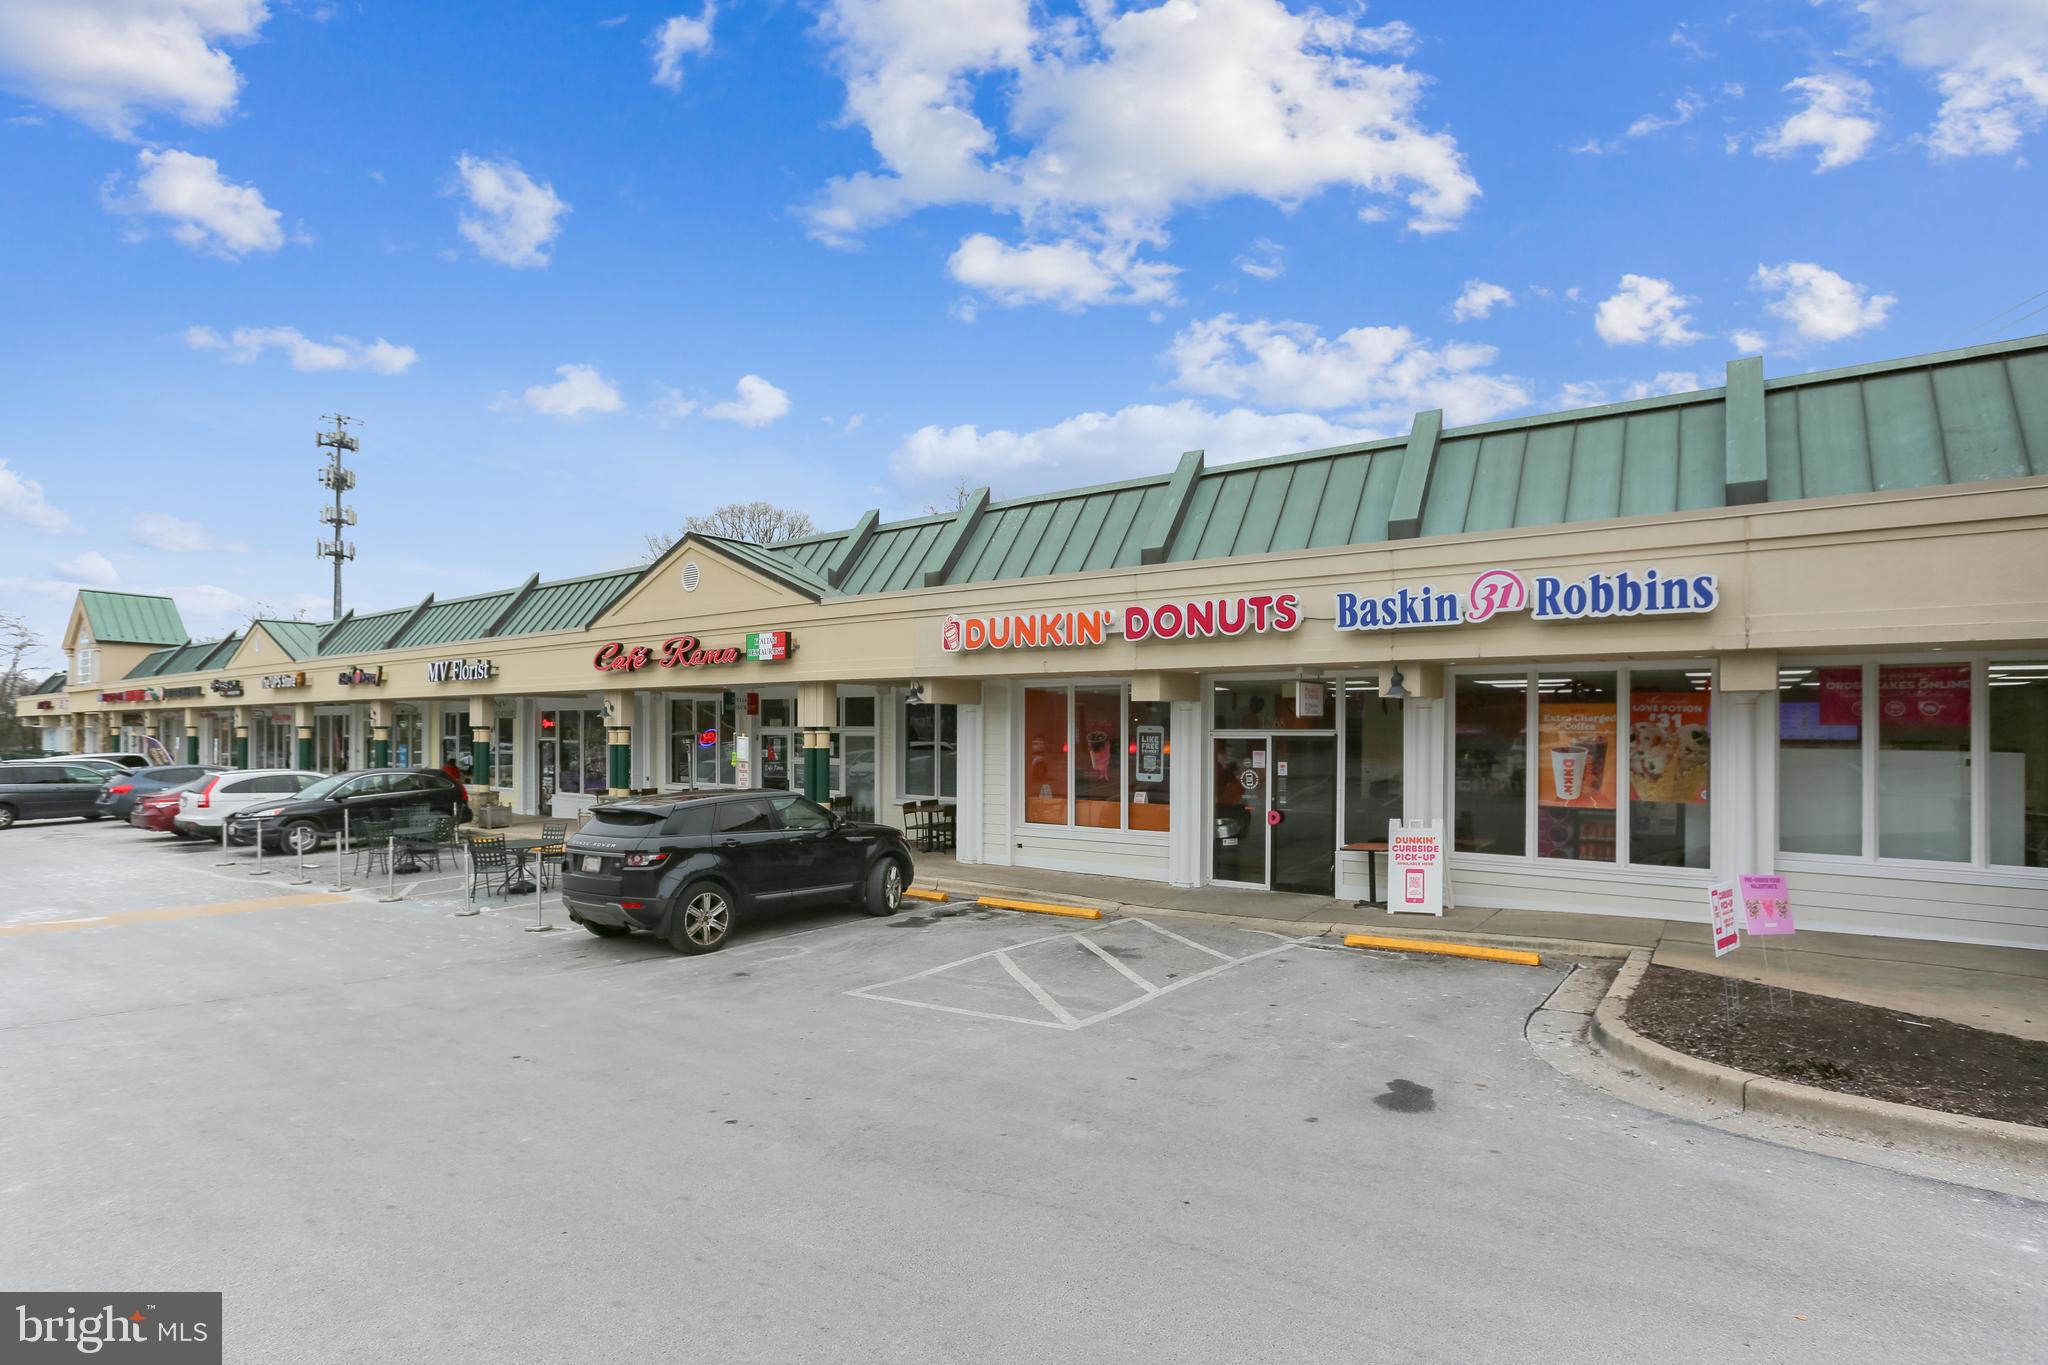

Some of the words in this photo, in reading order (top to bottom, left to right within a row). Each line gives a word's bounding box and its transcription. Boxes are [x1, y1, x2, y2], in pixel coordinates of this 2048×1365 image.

[1337, 586, 1460, 628] Baskin
[1468, 580, 1517, 621] 31
[1535, 569, 1714, 617] Robbins
[964, 608, 1111, 650] DUNKIN'
[1124, 593, 1298, 642] DONUTS
[754, 636, 778, 645] ITALIAN
[658, 635, 738, 669] Roma
[746, 646, 785, 657] RESTAURANT
[427, 660, 449, 683] MV
[451, 658, 490, 682] Florist
[1825, 680, 1863, 690] ORDE
[1878, 680, 1914, 689] AKES
[1918, 679, 1970, 689] ONLINE
[1632, 703, 1659, 713] LOVE
[1661, 703, 1703, 713] POTION
[1563, 722, 1596, 730] Coffee
[1141, 735, 1159, 743] LIKE
[1395, 836, 1436, 844] DUNKIN'
[1392, 844, 1440, 853] CURBSIDE
[1395, 853, 1436, 861] PICK-UP
